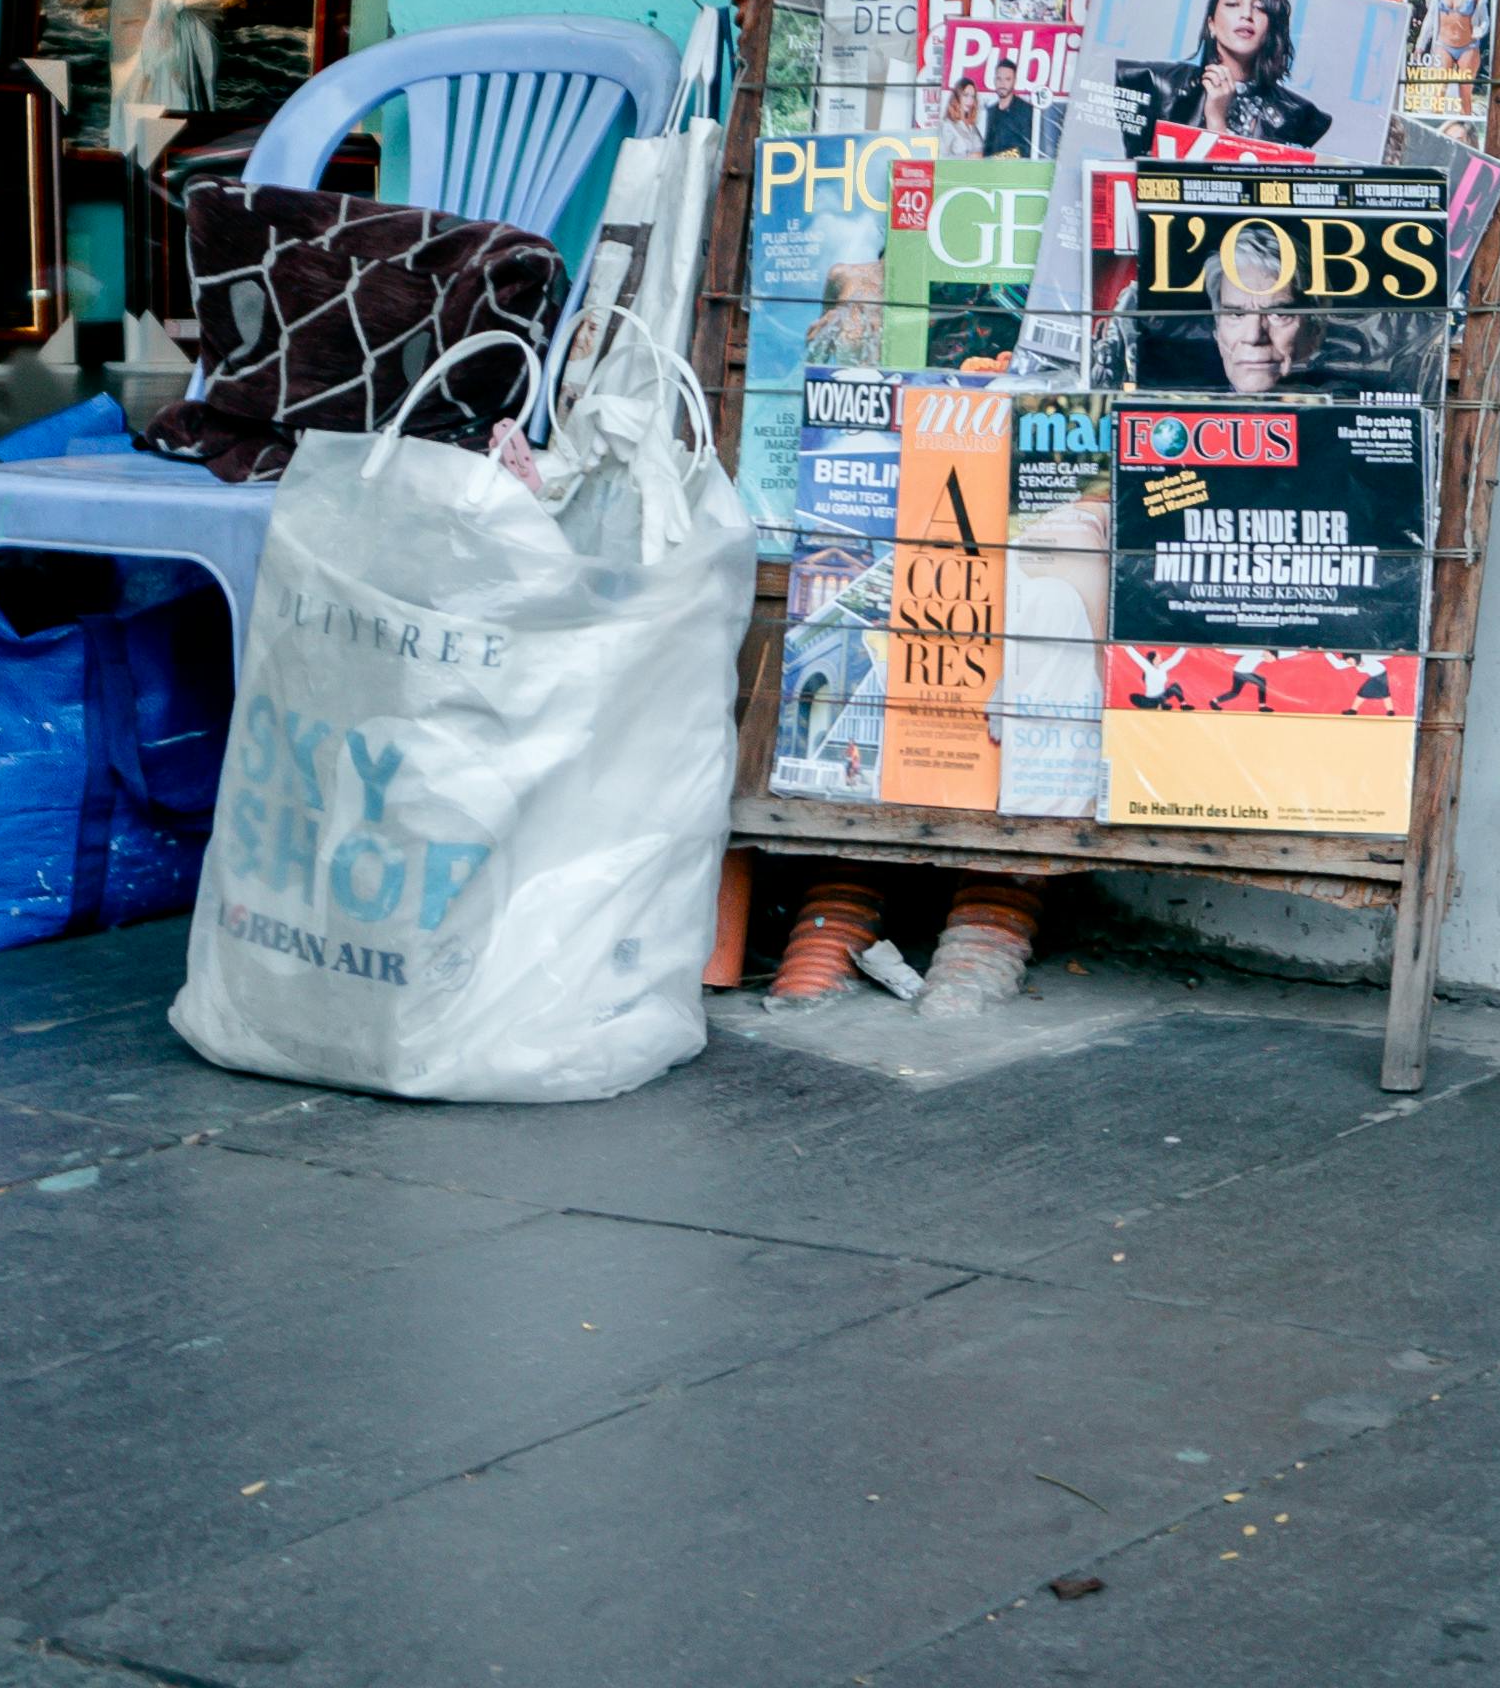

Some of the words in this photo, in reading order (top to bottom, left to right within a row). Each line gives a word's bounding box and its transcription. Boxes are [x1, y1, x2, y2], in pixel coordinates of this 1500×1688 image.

[1405, 66, 1474, 81] WEDDING
[1404, 96, 1463, 112] SECRETS
[897, 189, 927, 213] 40
[898, 212, 925, 228] ANS
[775, 257, 810, 270] PHOTO
[1147, 213, 1438, 301] L'OBS
[764, 271, 779, 284] DU
[781, 270, 820, 284] MONDE
[806, 381, 891, 427] VOYAGES
[776, 413, 796, 425] LES
[1355, 414, 1371, 428] Die
[1373, 414, 1412, 429] coolste
[915, 433, 1000, 452] FIGARO
[1123, 415, 1293, 463] FOCUS
[1369, 427, 1387, 439] der
[1387, 427, 1413, 440] Welt
[769, 452, 783, 464] DE
[1018, 462, 1055, 476] MARIE
[1057, 462, 1099, 476] CLAIRE
[1018, 474, 1077, 489] S'ENGAGE
[1145, 473, 1180, 492] Werden
[1181, 469, 1197, 482] Sie
[829, 490, 855, 505] HIGH
[856, 491, 888, 506] TECH
[814, 501, 829, 515] AU
[831, 502, 870, 517] GRAND
[912, 463, 990, 559] A
[1183, 508, 1234, 543] DAS
[1237, 509, 1298, 544] ENDE
[1301, 510, 1349, 545] DER
[1154, 541, 1379, 587] MITTELSCHICHT
[905, 556, 991, 602] CCE
[1190, 585, 1221, 600] (WIE
[1223, 585, 1251, 600] WIR
[1252, 586, 1274, 600] SIE
[1275, 586, 1338, 602] KENNEN)
[904, 642, 987, 689] RES
[1012, 729, 1061, 749] son
[239, 694, 403, 824] SKY
[1129, 800, 1148, 815] Die
[1150, 801, 1204, 817] Heilkraft
[1206, 803, 1228, 818] des
[1230, 804, 1269, 820] Lichts
[231, 786, 491, 932] SHOP
[333, 941, 409, 987] AIR
